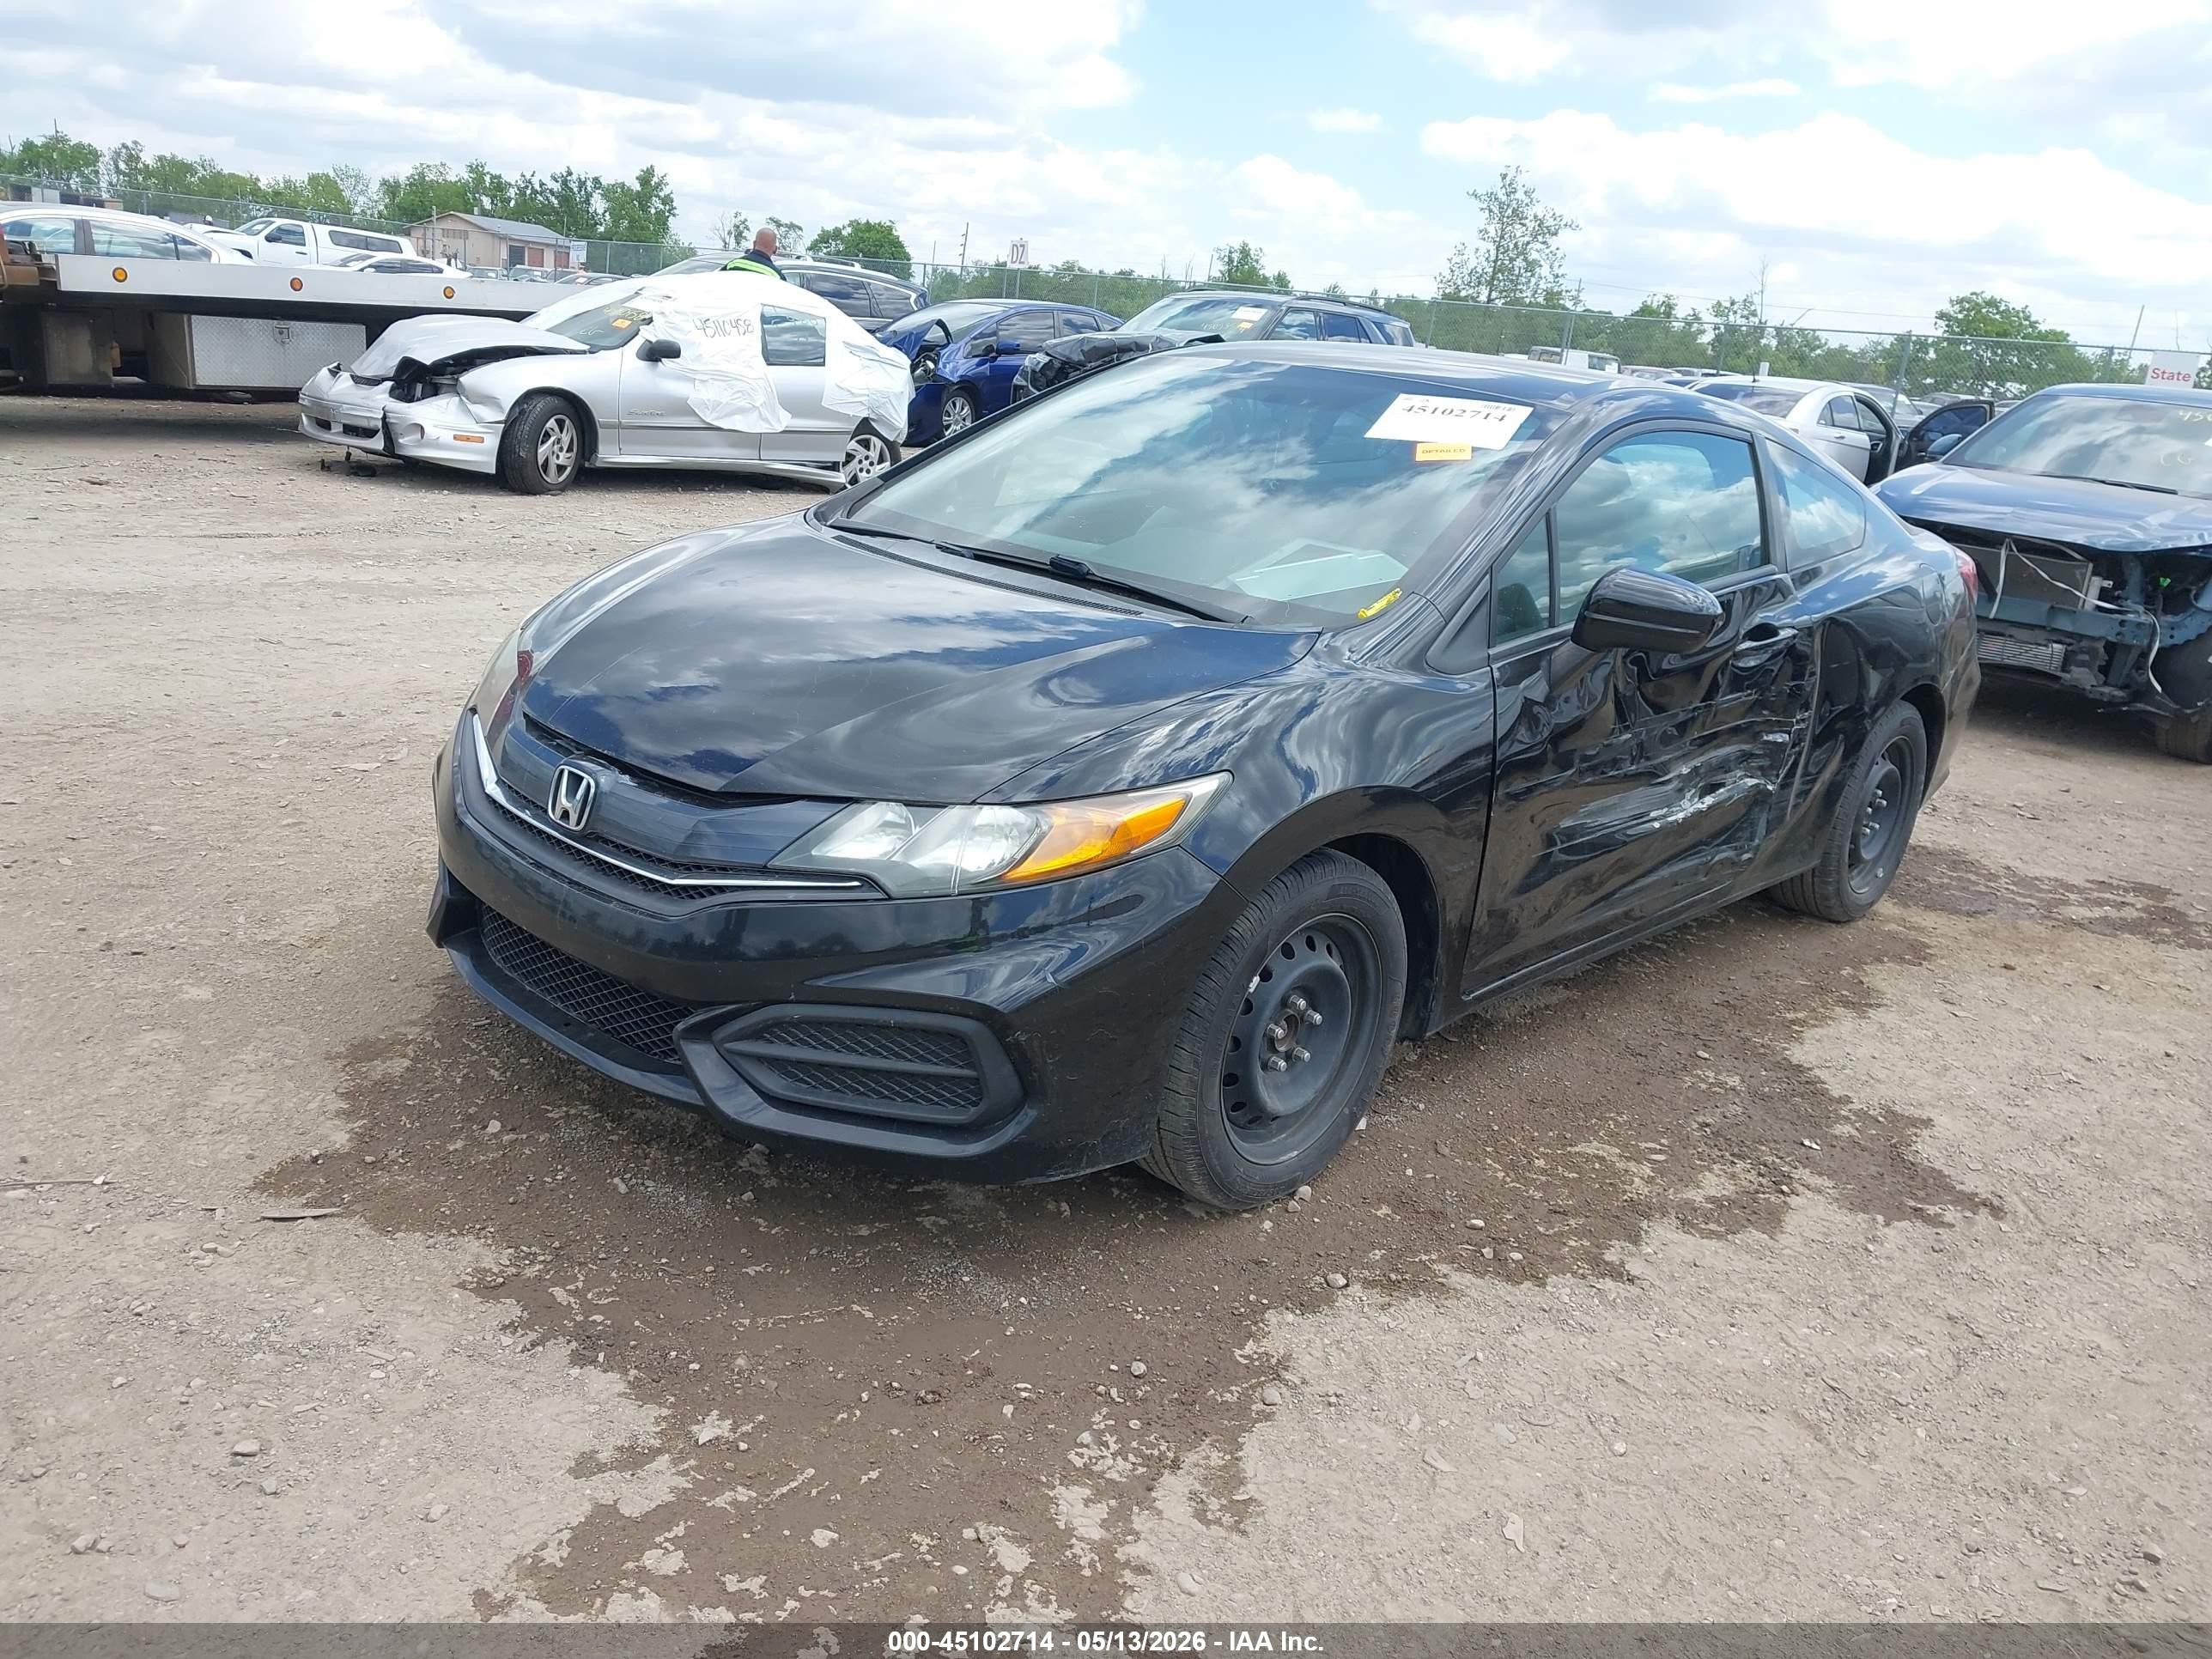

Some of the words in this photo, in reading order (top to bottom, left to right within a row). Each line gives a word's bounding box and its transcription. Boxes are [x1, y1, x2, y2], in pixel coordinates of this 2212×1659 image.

[1011, 244, 1025, 264] DZ
[2150, 368, 2191, 382] State
[1401, 404, 1507, 423] 45102714
